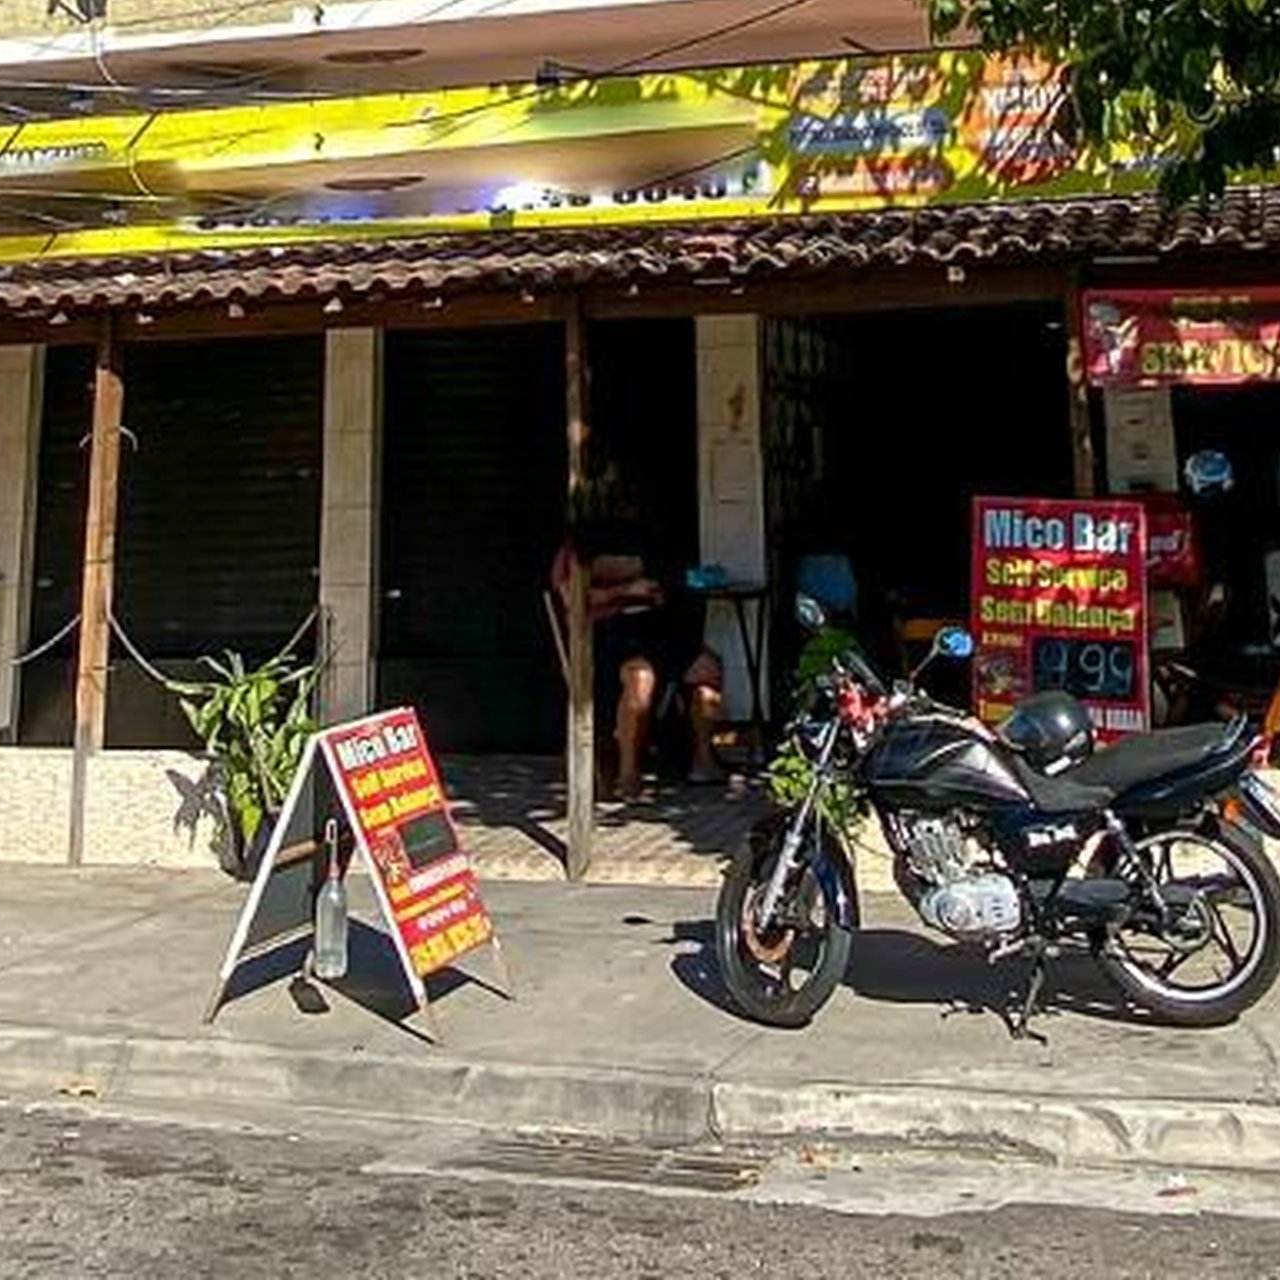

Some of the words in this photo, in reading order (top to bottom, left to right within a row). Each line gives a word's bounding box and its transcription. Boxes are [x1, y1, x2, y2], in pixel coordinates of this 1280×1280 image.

[982, 509, 1065, 550] Mico
[1072, 513, 1134, 554] Bar
[980, 595, 1032, 625] Sem
[335, 733, 388, 772] Mico
[382, 723, 419, 756] Bar
